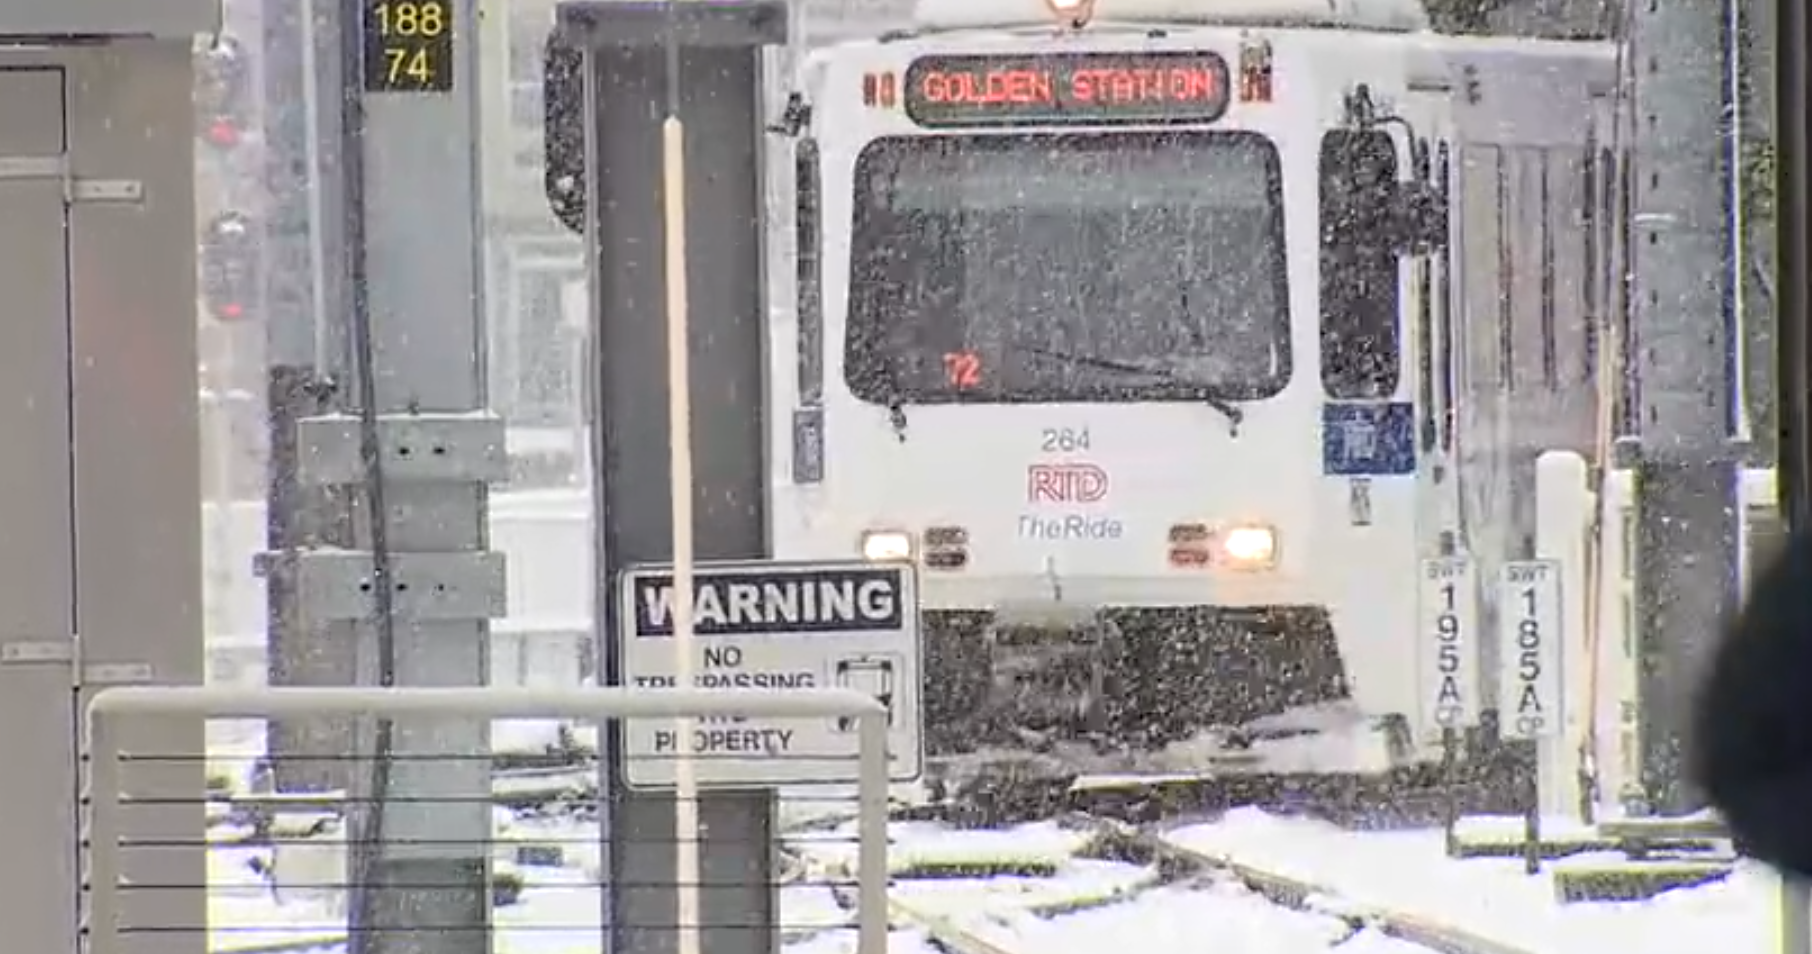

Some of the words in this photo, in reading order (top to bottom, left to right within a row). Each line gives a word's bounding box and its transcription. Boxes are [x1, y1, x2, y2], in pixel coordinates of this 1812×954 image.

[374, 2, 442, 36] 188
[384, 48, 437, 83] 74
[922, 71, 1051, 104] GOLDEN
[1071, 69, 1214, 100] STATION
[1027, 463, 1108, 502] RTD
[1507, 565, 1549, 582] SWT
[643, 579, 894, 626] WARNING
[703, 646, 742, 668] NO
[1437, 582, 1461, 702] 195A
[1517, 587, 1542, 713] 185A
[655, 730, 793, 752] POPERTY
